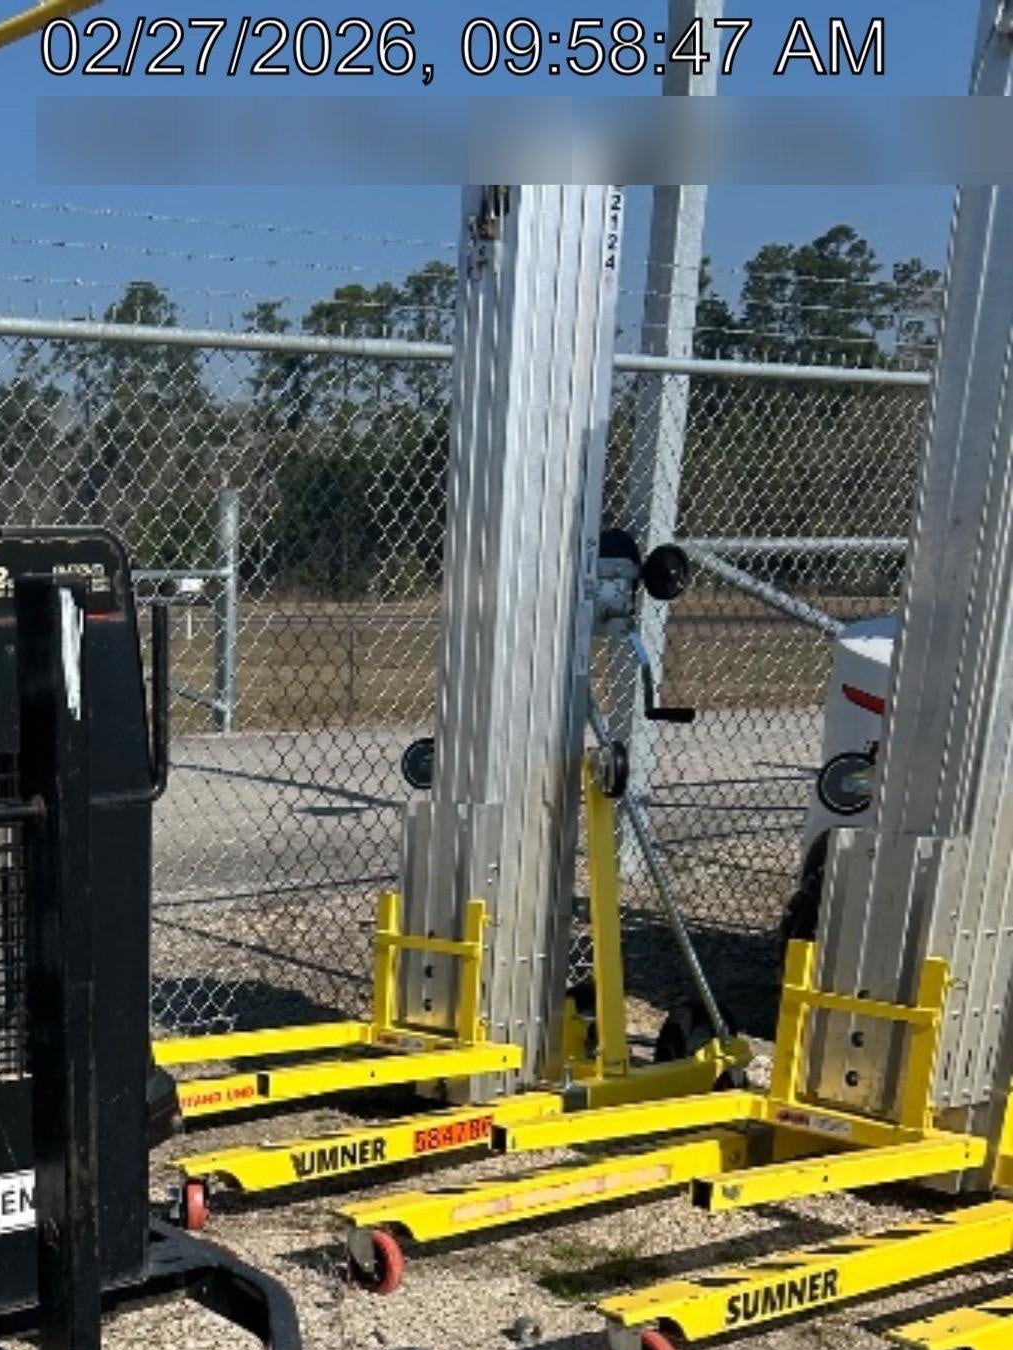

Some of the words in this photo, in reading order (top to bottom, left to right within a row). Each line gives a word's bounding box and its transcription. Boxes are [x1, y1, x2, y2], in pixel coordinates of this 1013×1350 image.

[605, 185, 624, 270] 2124
[290, 1137, 385, 1177] UMNER
[725, 1268, 838, 1324] SUMNER
